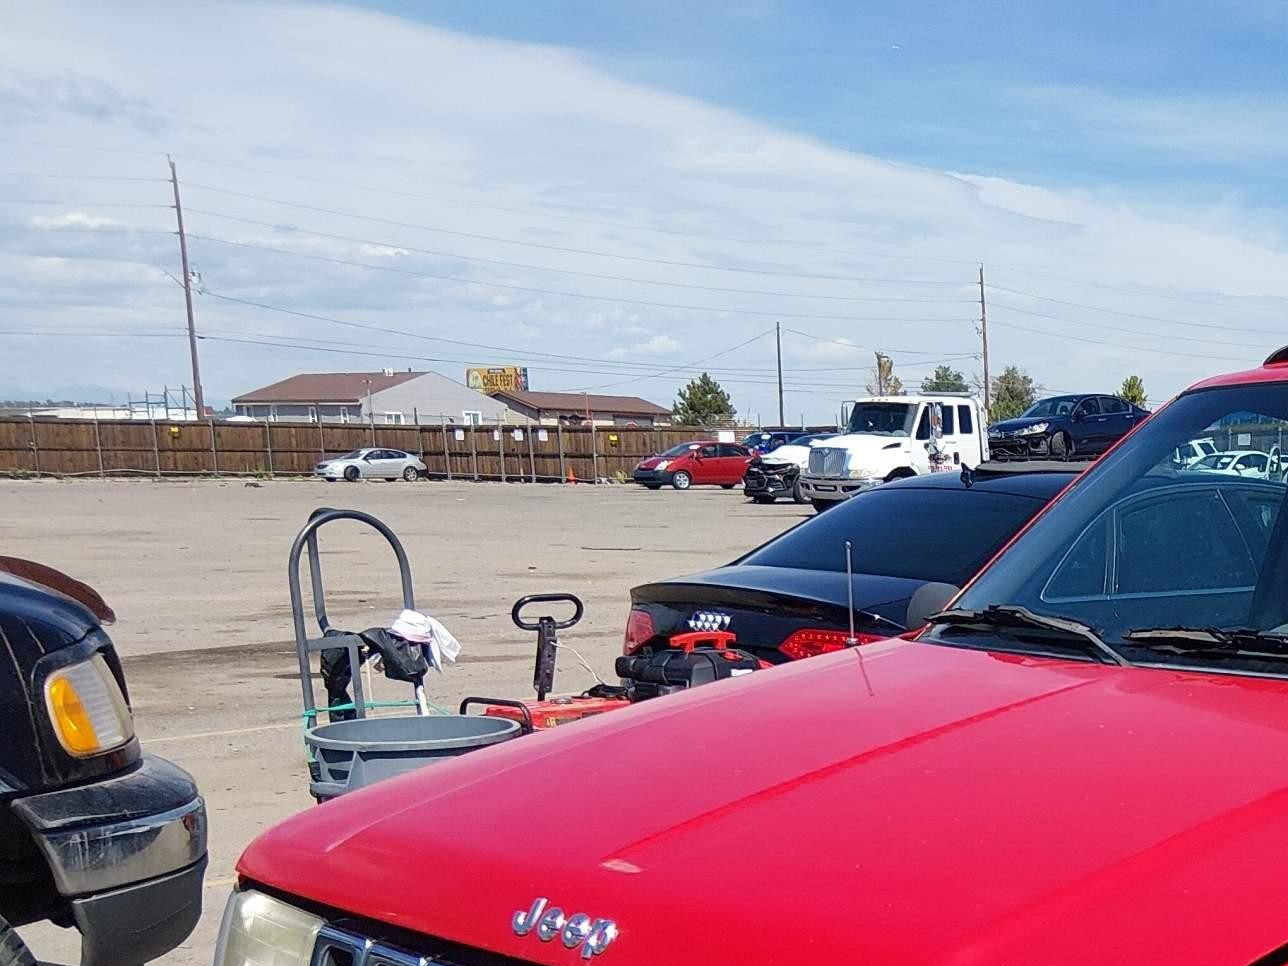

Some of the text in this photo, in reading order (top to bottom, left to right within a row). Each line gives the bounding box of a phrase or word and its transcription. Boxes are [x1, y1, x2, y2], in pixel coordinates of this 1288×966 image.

[483, 374, 513, 387] CHILE FEST
[512, 897, 617, 959] Jeep
